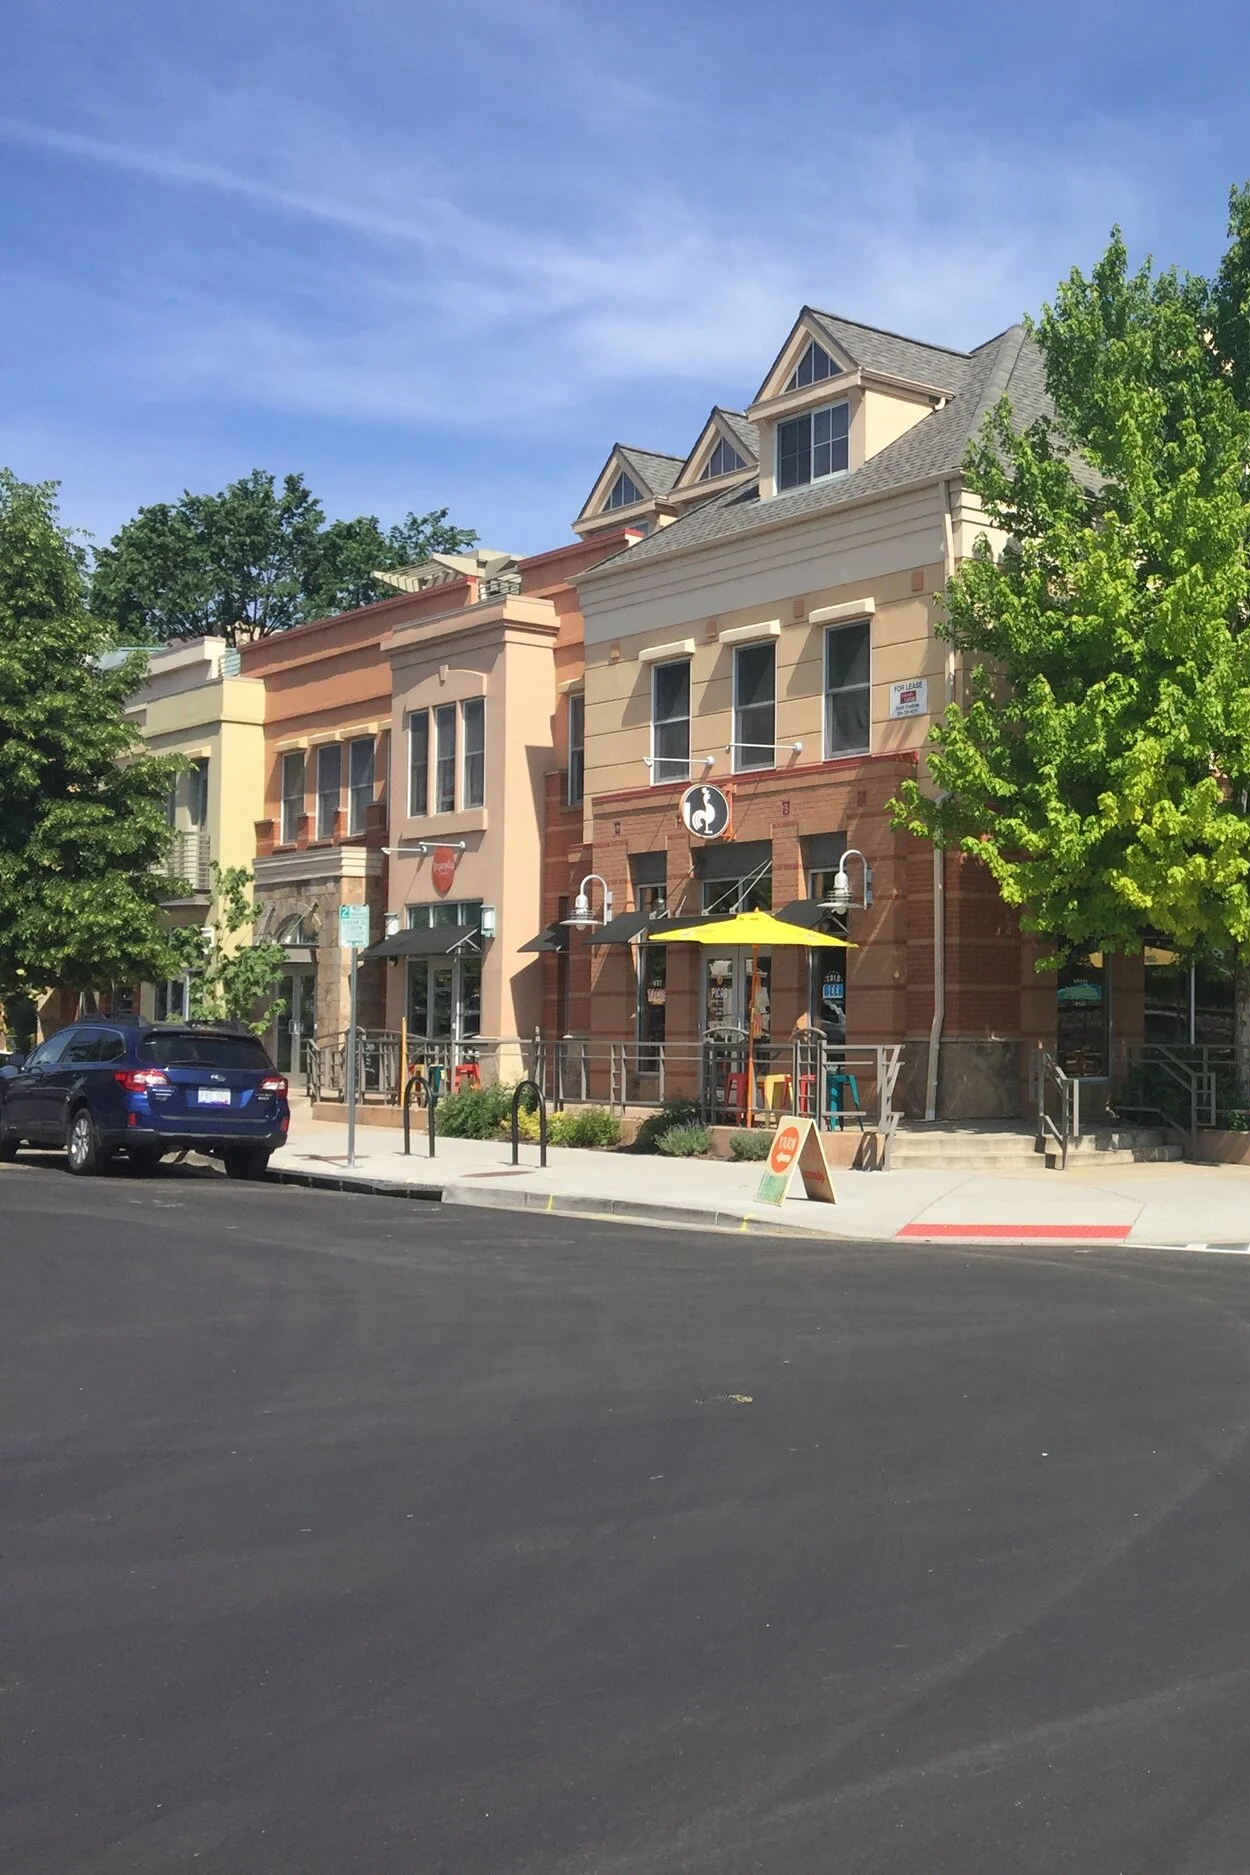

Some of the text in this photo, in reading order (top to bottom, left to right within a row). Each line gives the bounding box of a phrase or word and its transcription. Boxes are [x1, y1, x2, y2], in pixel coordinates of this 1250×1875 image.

[906, 681, 922, 690] LEASE
[341, 906, 349, 918] 2
[823, 984, 843, 998] BEER
[778, 1136, 797, 1150] YARN
